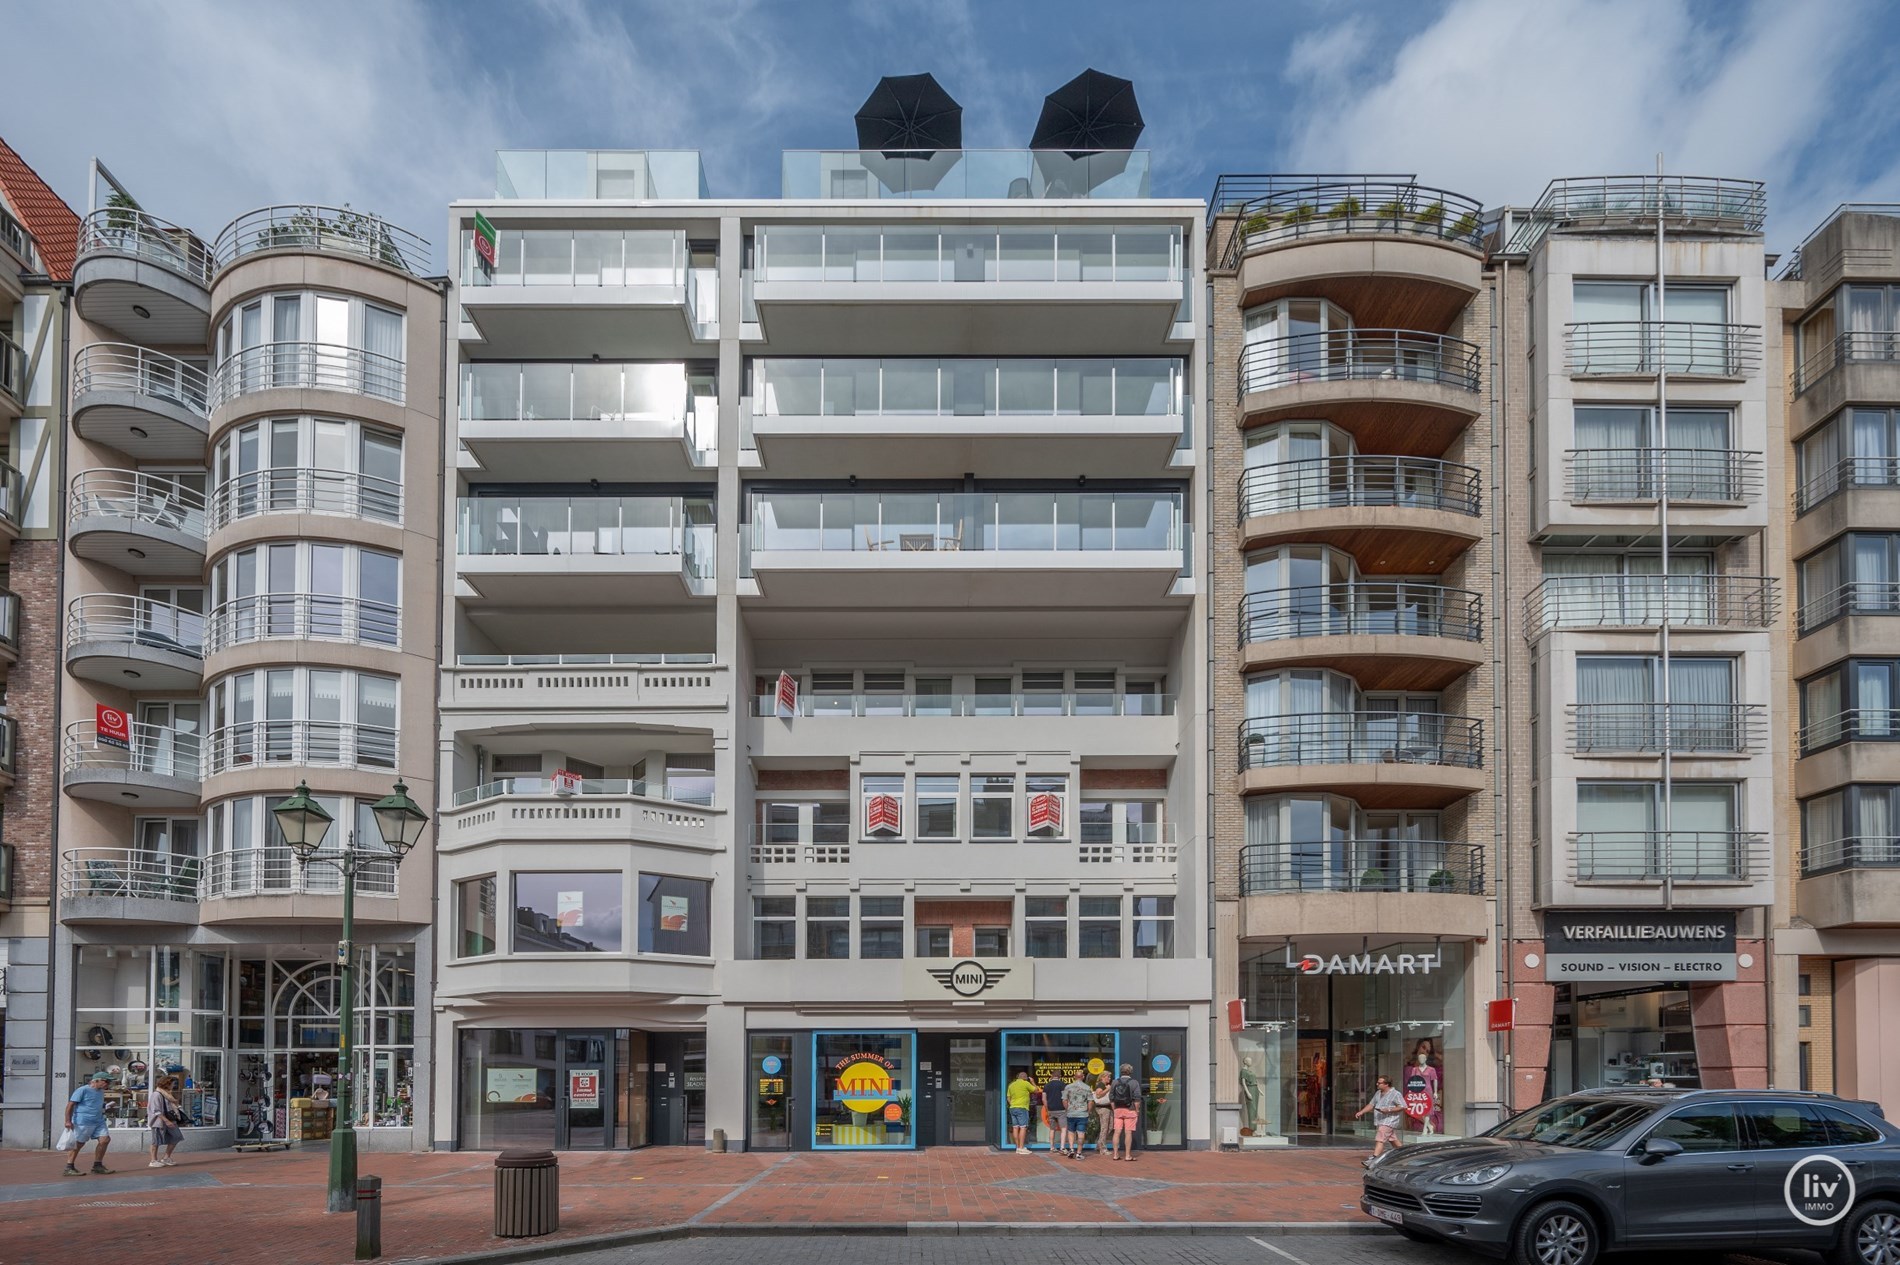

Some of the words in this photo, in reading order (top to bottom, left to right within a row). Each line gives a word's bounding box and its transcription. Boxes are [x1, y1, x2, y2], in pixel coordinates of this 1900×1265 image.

[1299, 954, 1436, 975] DAMART
[1561, 962, 1604, 972] SOUND
[1619, 962, 1660, 972] VISION
[1674, 962, 1722, 972] ELECTRO
[955, 974, 982, 984] MINI
[835, 1056, 850, 1070] THE
[850, 1052, 885, 1064] SUMMER
[884, 1060, 895, 1070] OF
[835, 1077, 895, 1097] MINI
[1407, 1092, 1429, 1102] SALE
